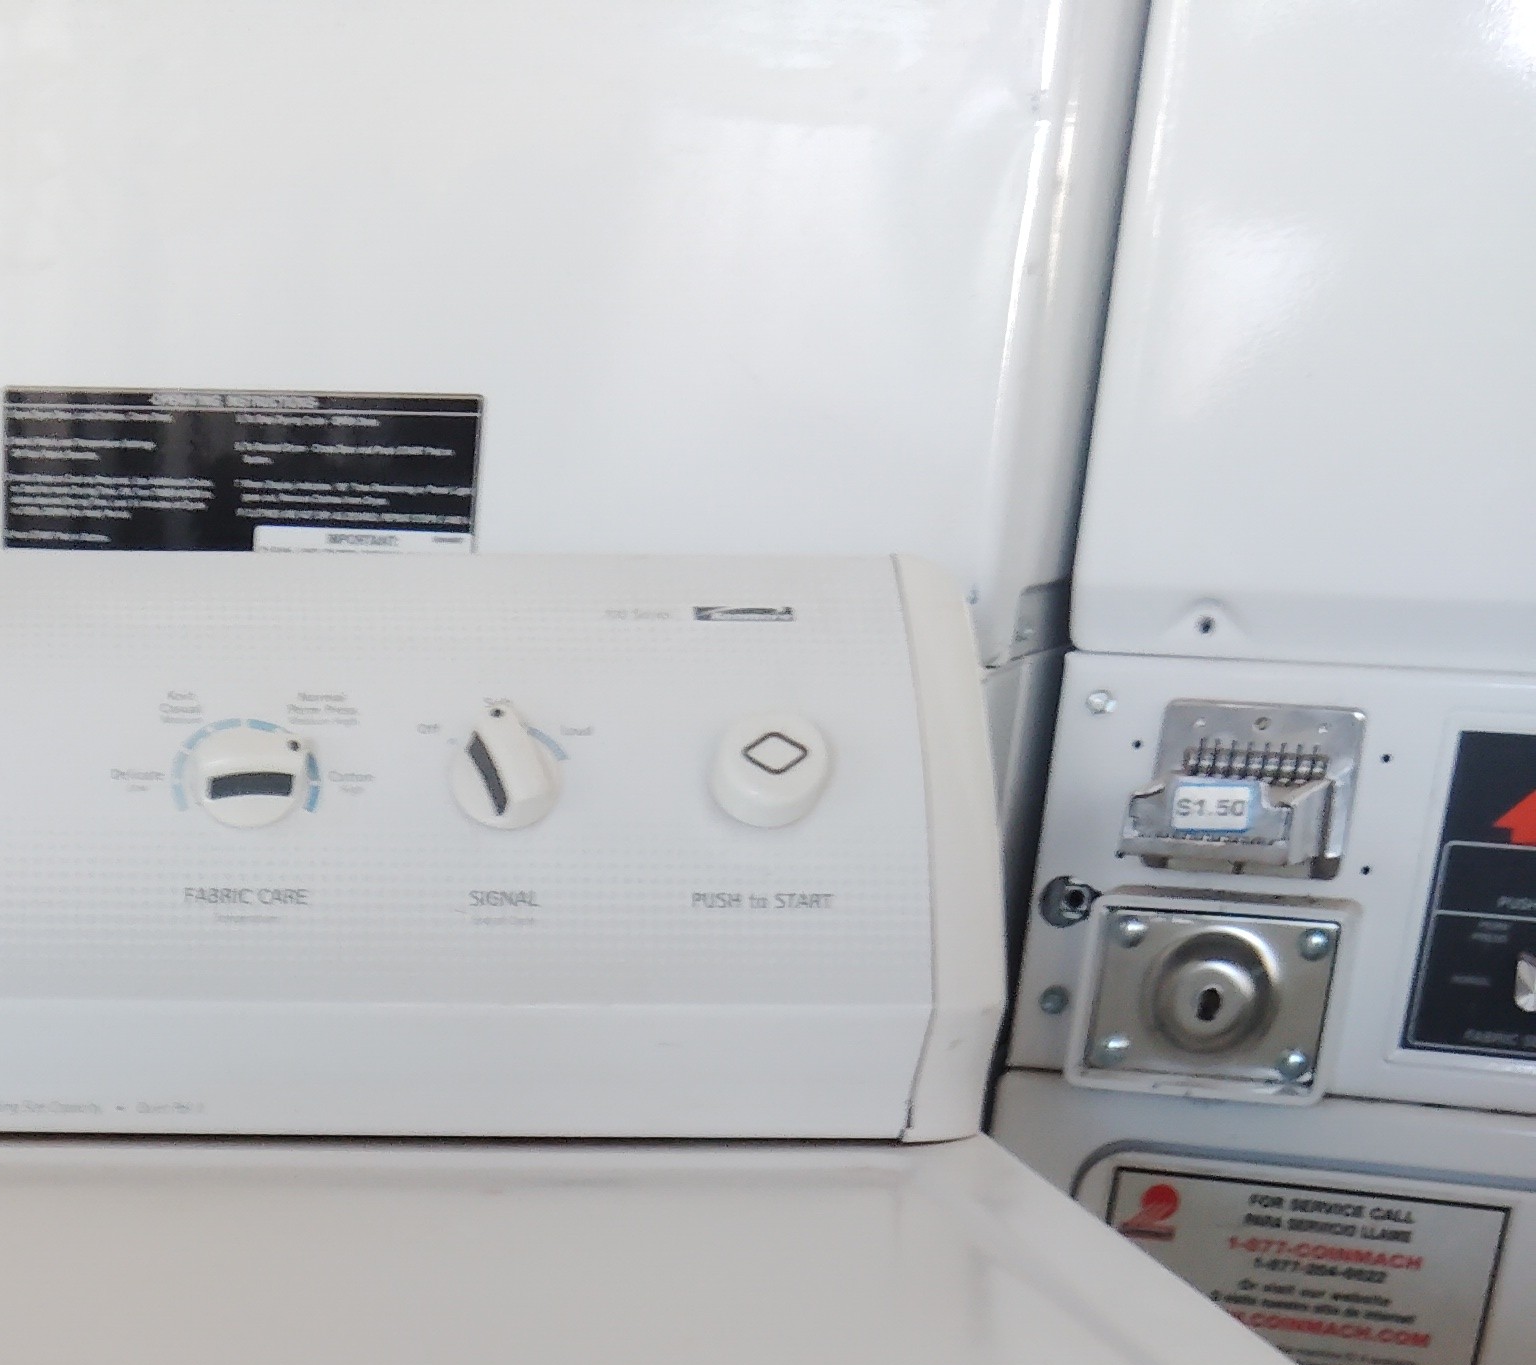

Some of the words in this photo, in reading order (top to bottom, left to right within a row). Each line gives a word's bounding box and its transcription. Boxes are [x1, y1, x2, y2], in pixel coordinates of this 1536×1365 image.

[1175, 797, 1248, 817] $1.50
[184, 886, 253, 905] FABRIC
[257, 887, 311, 906] CARE
[468, 889, 542, 907] SIGNAL
[691, 891, 743, 909] PUSH
[773, 891, 836, 909] START
[1249, 1193, 1284, 1209] FOR
[1291, 1198, 1365, 1218] SERVICE
[1370, 1206, 1415, 1225] CALL
[1228, 1235, 1424, 1271] 1-877-COINMACH
